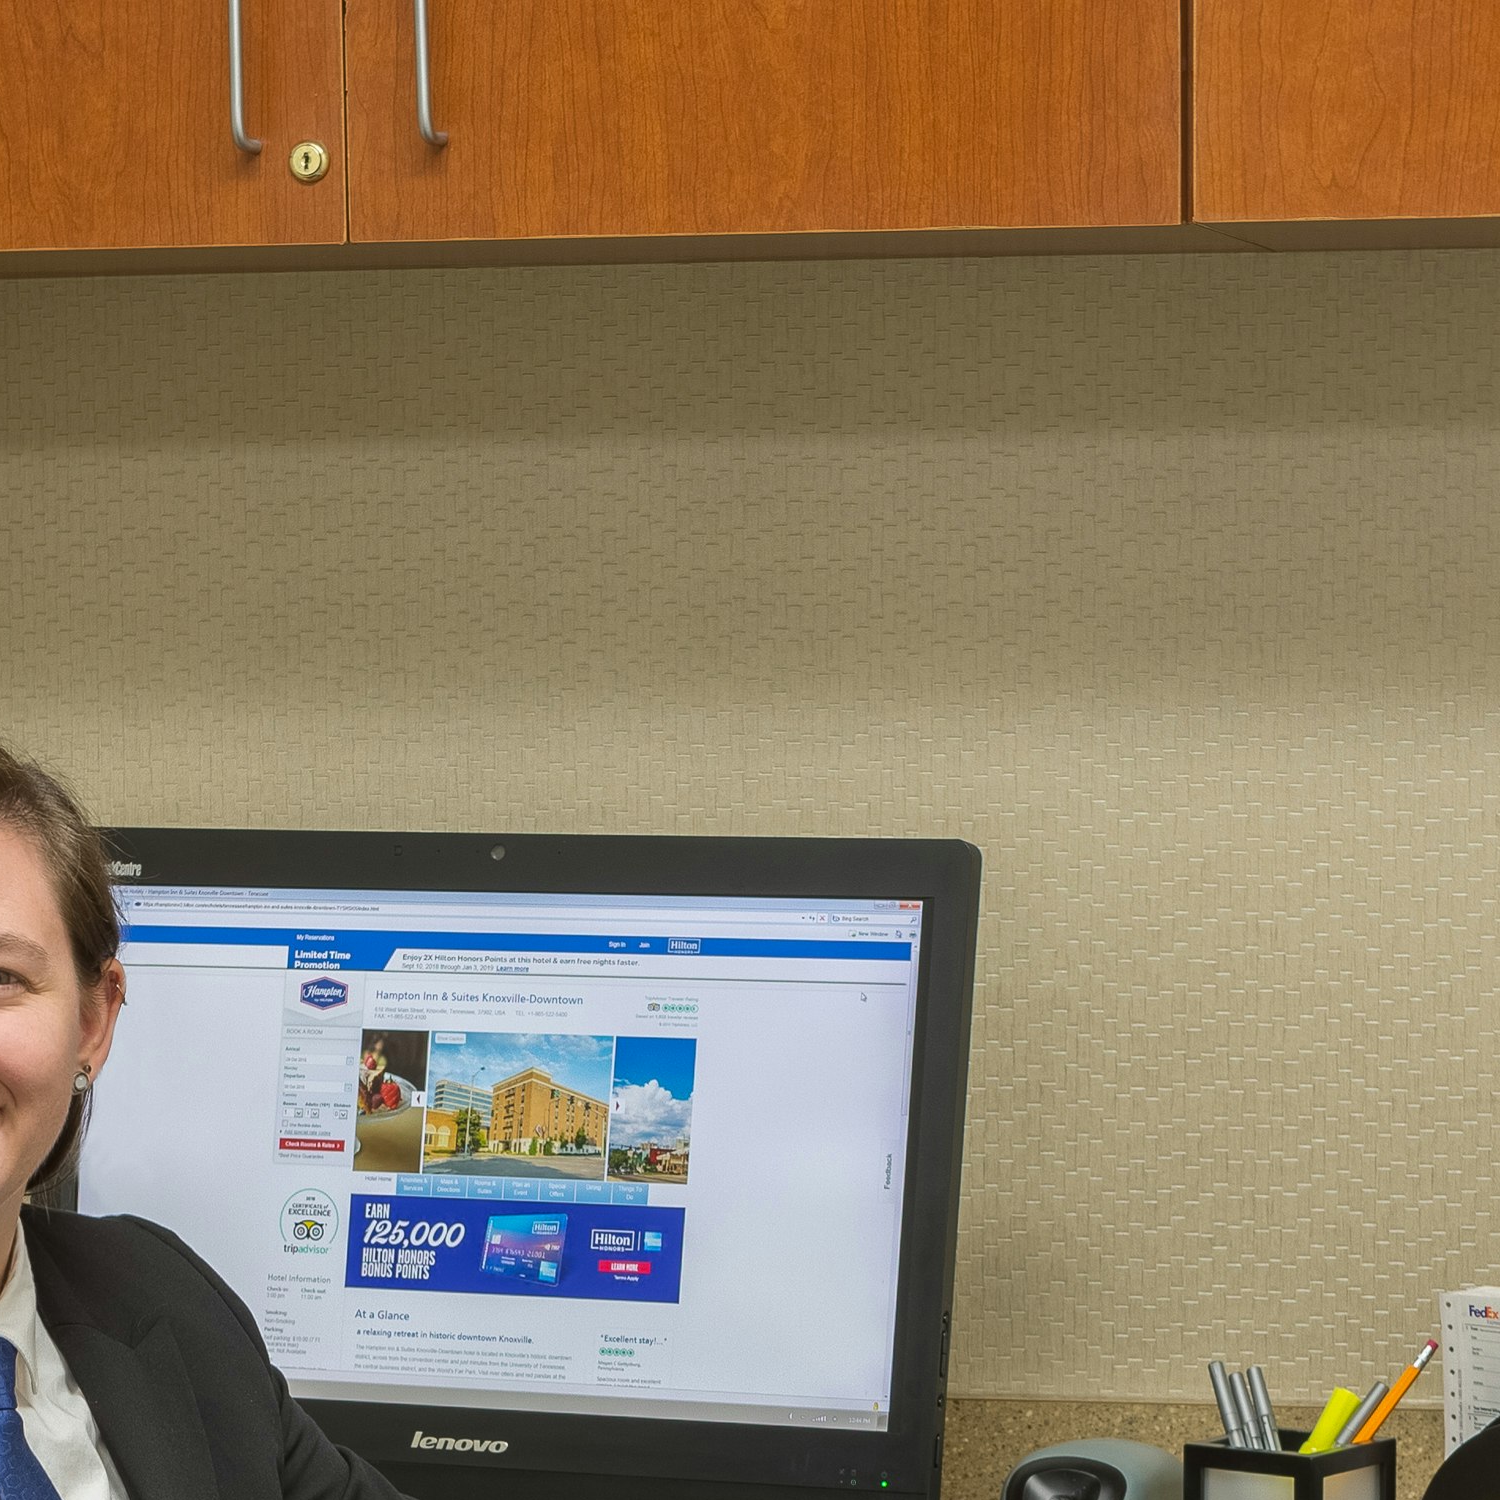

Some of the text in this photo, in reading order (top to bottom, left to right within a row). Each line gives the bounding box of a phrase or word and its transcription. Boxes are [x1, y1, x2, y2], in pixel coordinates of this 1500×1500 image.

[608, 941, 620, 949] Sign
[670, 940, 698, 950] Hilton
[294, 949, 352, 960] Limited Time
[402, 953, 422, 961] Enjoy
[484, 955, 508, 963] Points
[593, 959, 616, 967] nights
[294, 961, 340, 970] Promotion
[303, 984, 346, 998] Hampton
[376, 990, 584, 1005] Hampton Inn & Suites Knoxville-Downtown
[883, 1153, 892, 1190] Feedback
[288, 1208, 331, 1217] EXCELLENCE
[365, 1202, 390, 1219] EARN
[363, 1219, 466, 1249] 125,000
[534, 1223, 557, 1232] Hilton
[594, 1232, 631, 1246] Hilton
[283, 1243, 329, 1255] tripadvisor
[362, 1247, 436, 1266] HILTON HONORS
[361, 1262, 430, 1280] BONUS POINTS
[267, 1273, 332, 1284] Hotel Information
[354, 1308, 410, 1321] At a Glance
[1468, 1304, 1499, 1320] FedEx
[362, 1328, 392, 1338] relaxing
[393, 1330, 419, 1338] retreat
[420, 1330, 428, 1338] in
[429, 1331, 455, 1340] historic
[457, 1332, 497, 1342] downtown
[498, 1335, 535, 1345] Knoxville.
[410, 1430, 509, 1454] lenovo
